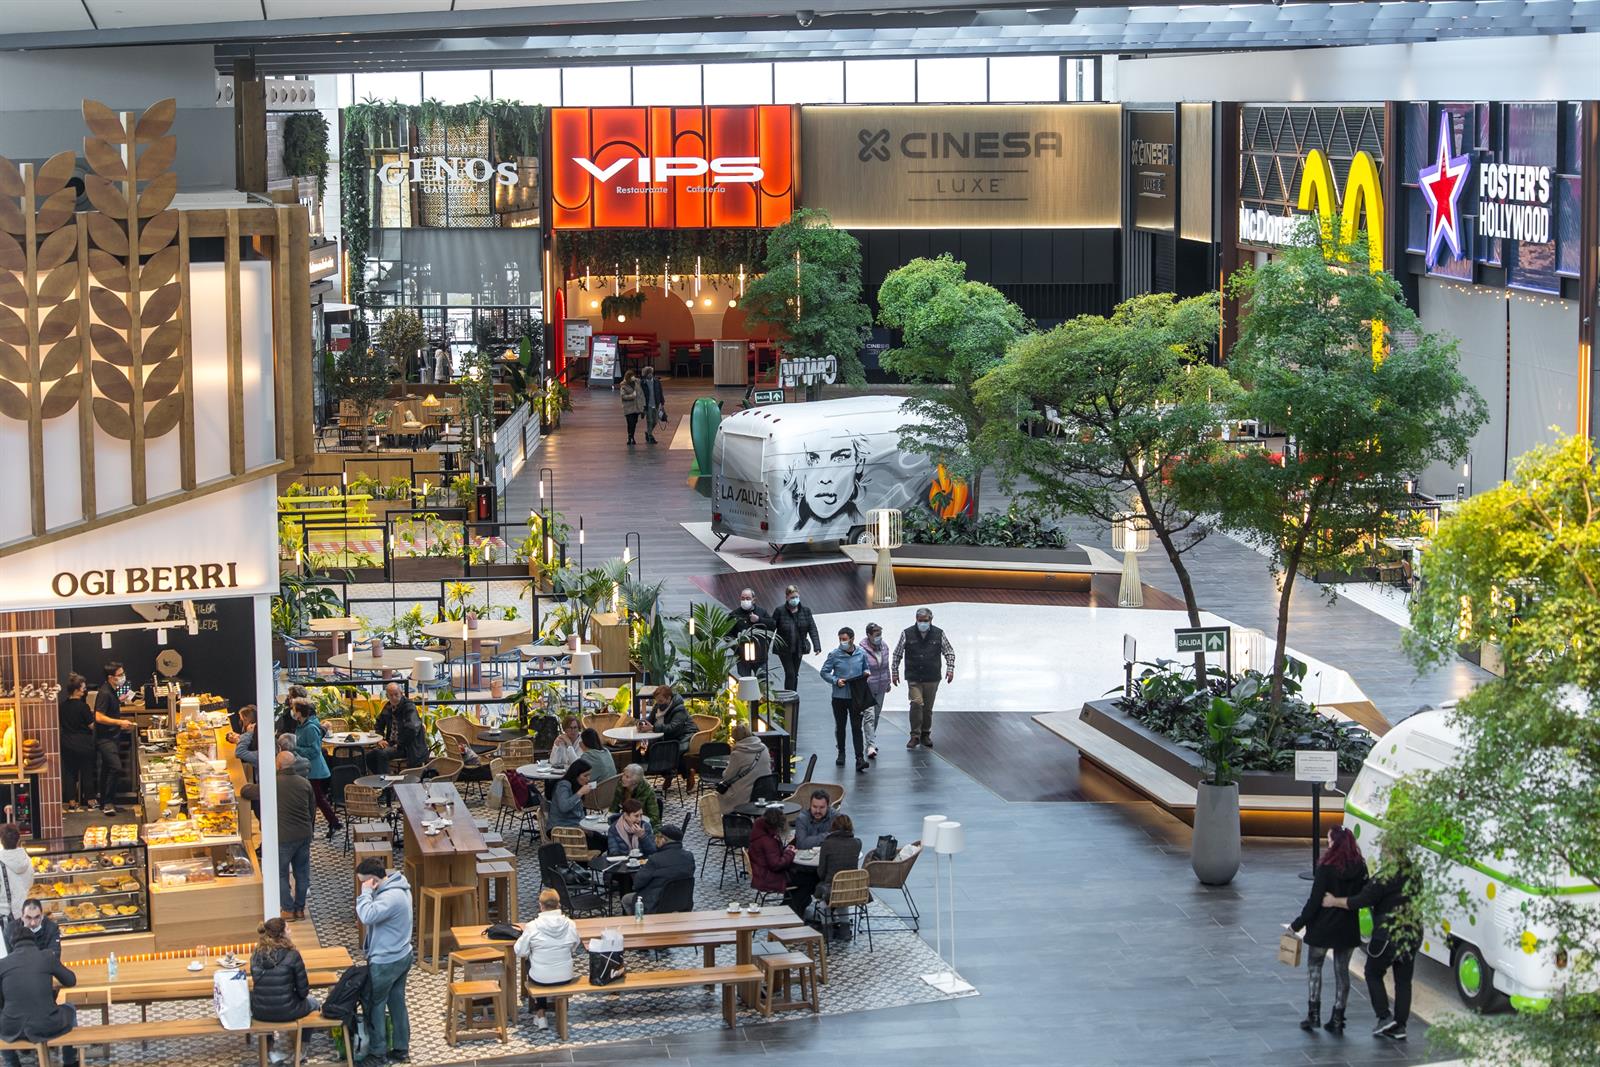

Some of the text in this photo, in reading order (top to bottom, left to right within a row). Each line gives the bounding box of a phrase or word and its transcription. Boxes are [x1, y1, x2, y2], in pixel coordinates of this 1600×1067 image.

[900, 131, 1063, 159] CINESA
[377, 156, 519, 186] GINOS
[572, 157, 765, 183] VIPS
[1480, 163, 1549, 203] FOSTER'S
[616, 186, 668, 194] Restaurante
[937, 178, 1001, 193] LUXE
[1480, 202, 1549, 243] HOLLYWOOD
[721, 484, 735, 501] LA
[52, 562, 239, 597] OGI BERRI
[1178, 638, 1202, 648] SALIDA
